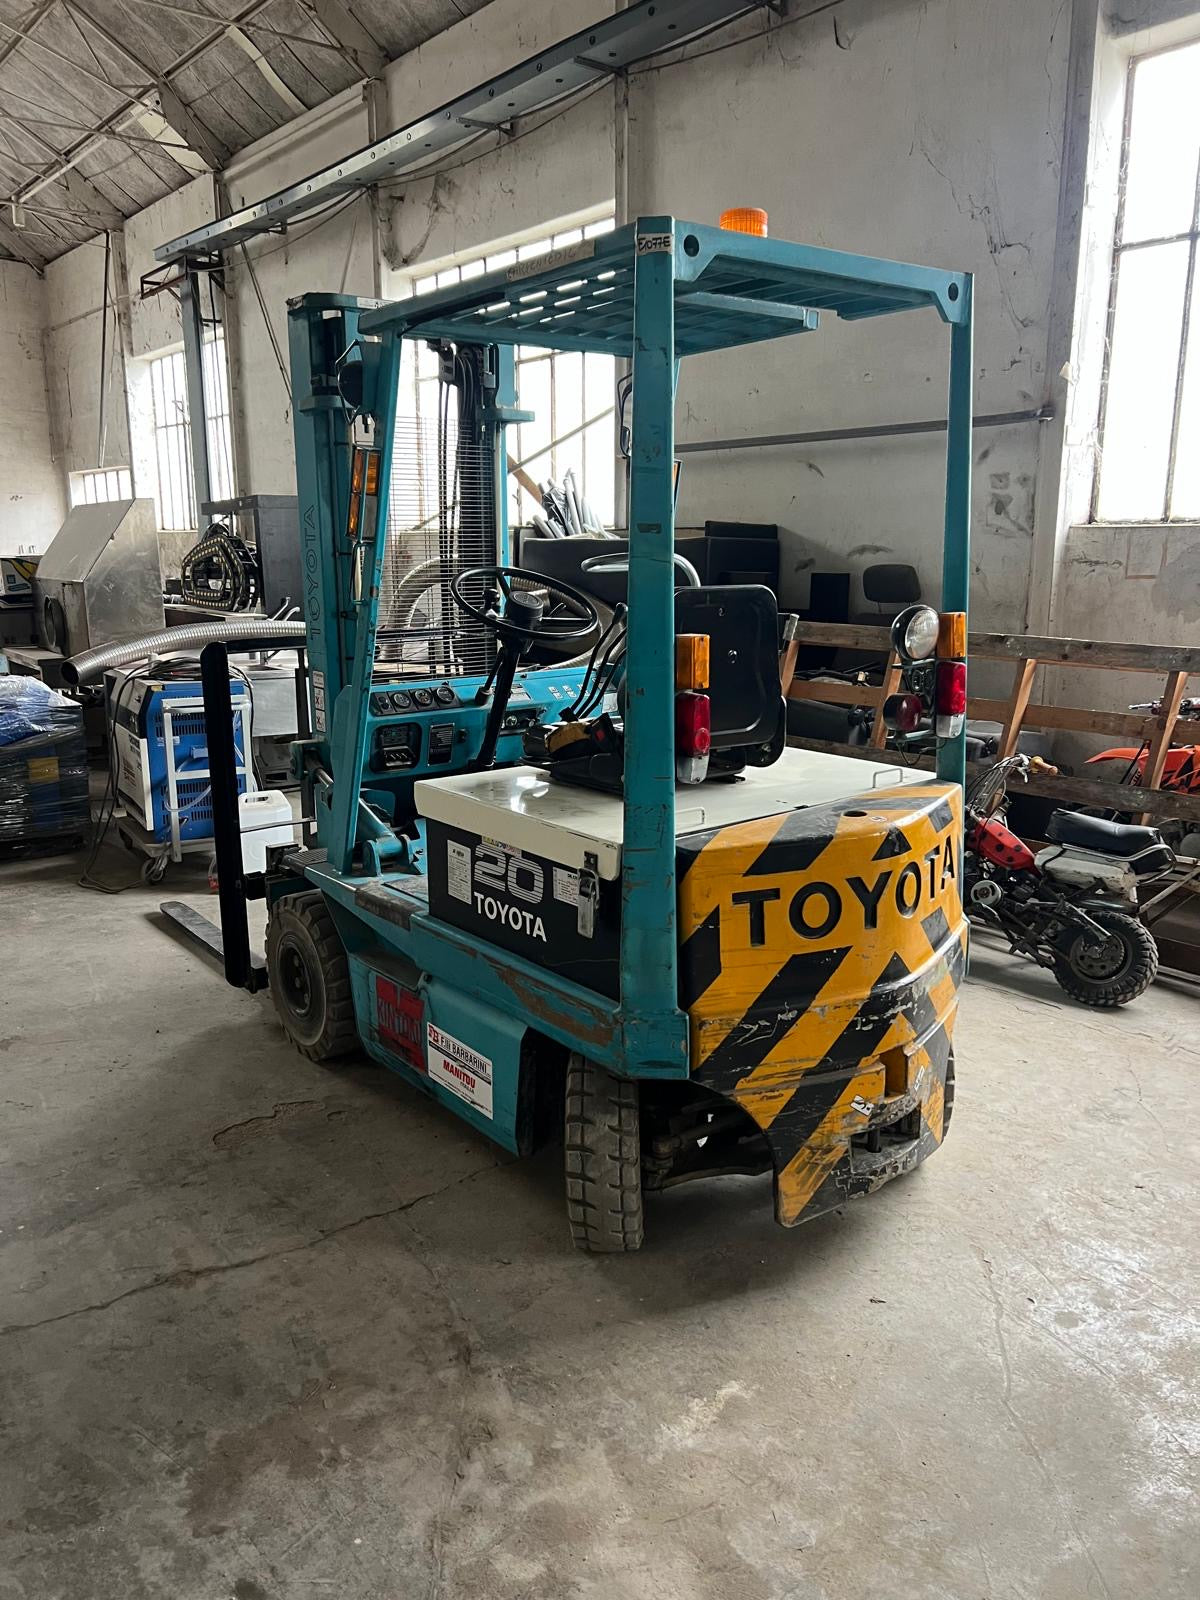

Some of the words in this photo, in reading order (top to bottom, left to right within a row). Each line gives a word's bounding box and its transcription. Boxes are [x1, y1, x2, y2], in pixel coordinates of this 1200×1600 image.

[304, 504, 321, 641] TOYOTA
[474, 844, 544, 904] 20
[732, 835, 955, 947] TOYOTA
[474, 892, 547, 942] TOYOTA
[443, 1060, 476, 1089] MANITOU
[452, 1043, 488, 1074] BARBARINI
